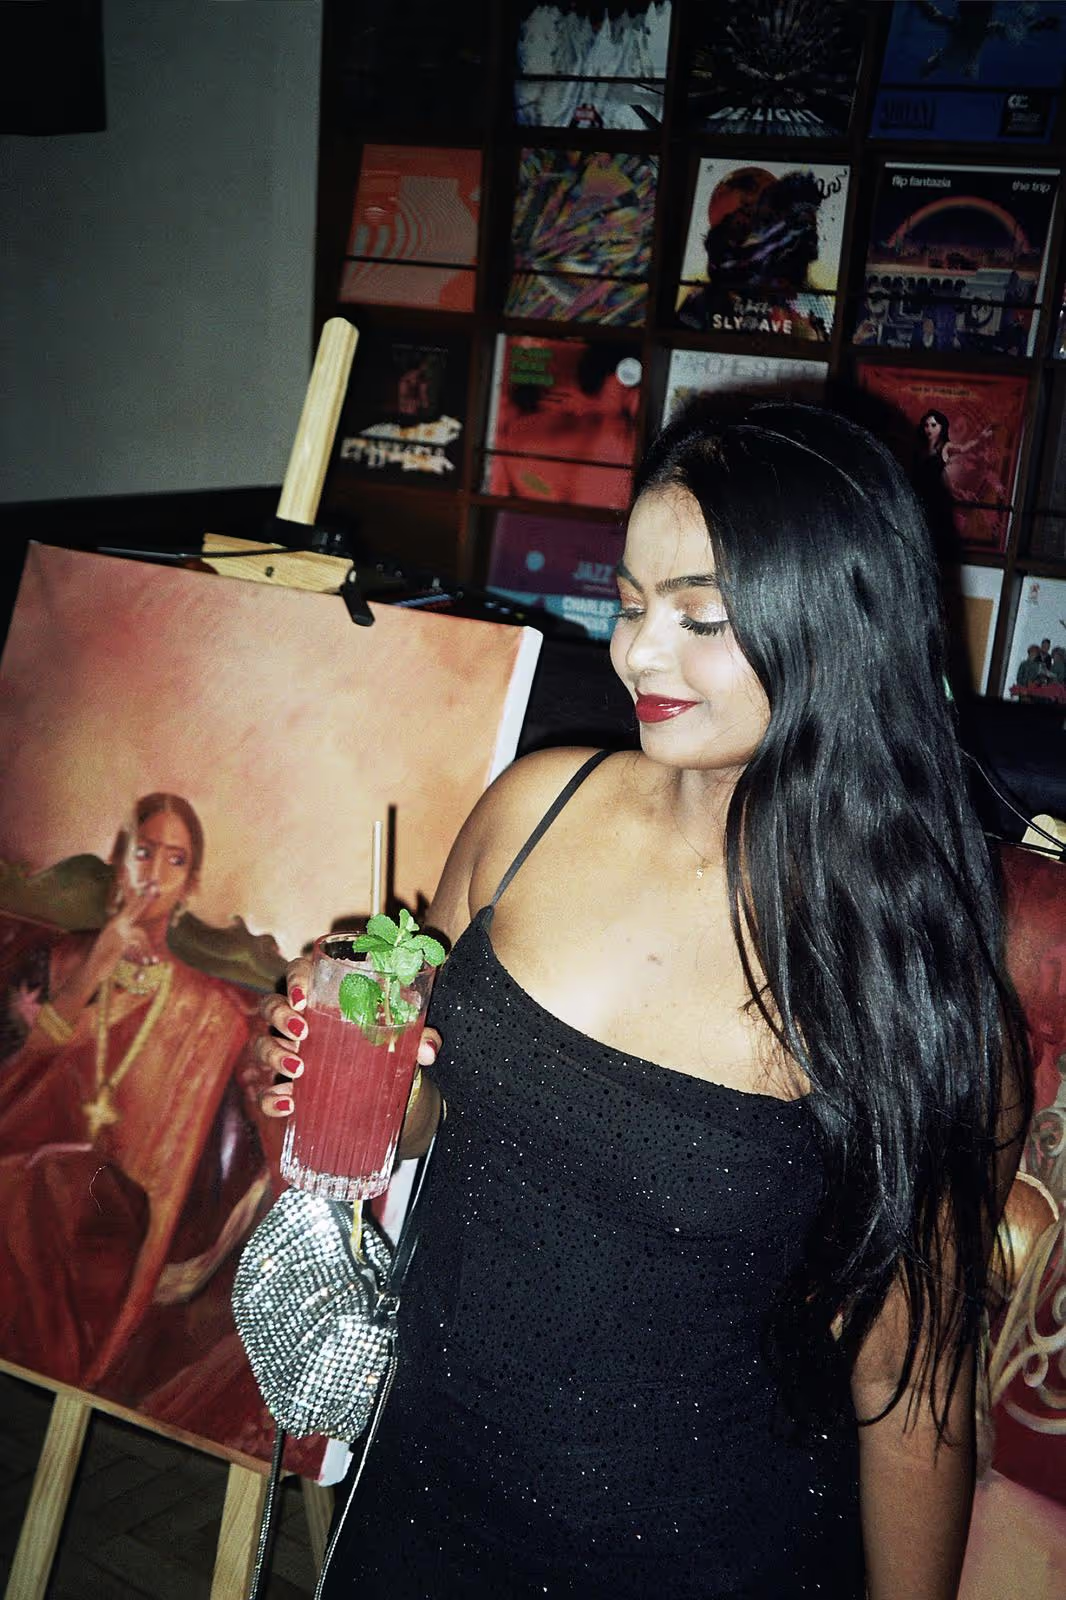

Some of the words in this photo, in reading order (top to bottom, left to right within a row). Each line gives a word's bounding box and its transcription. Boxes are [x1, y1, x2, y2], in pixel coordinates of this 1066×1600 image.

[891, 174, 908, 189] flip
[1011, 181, 1029, 192] the
[573, 561, 613, 584] JAZZ
